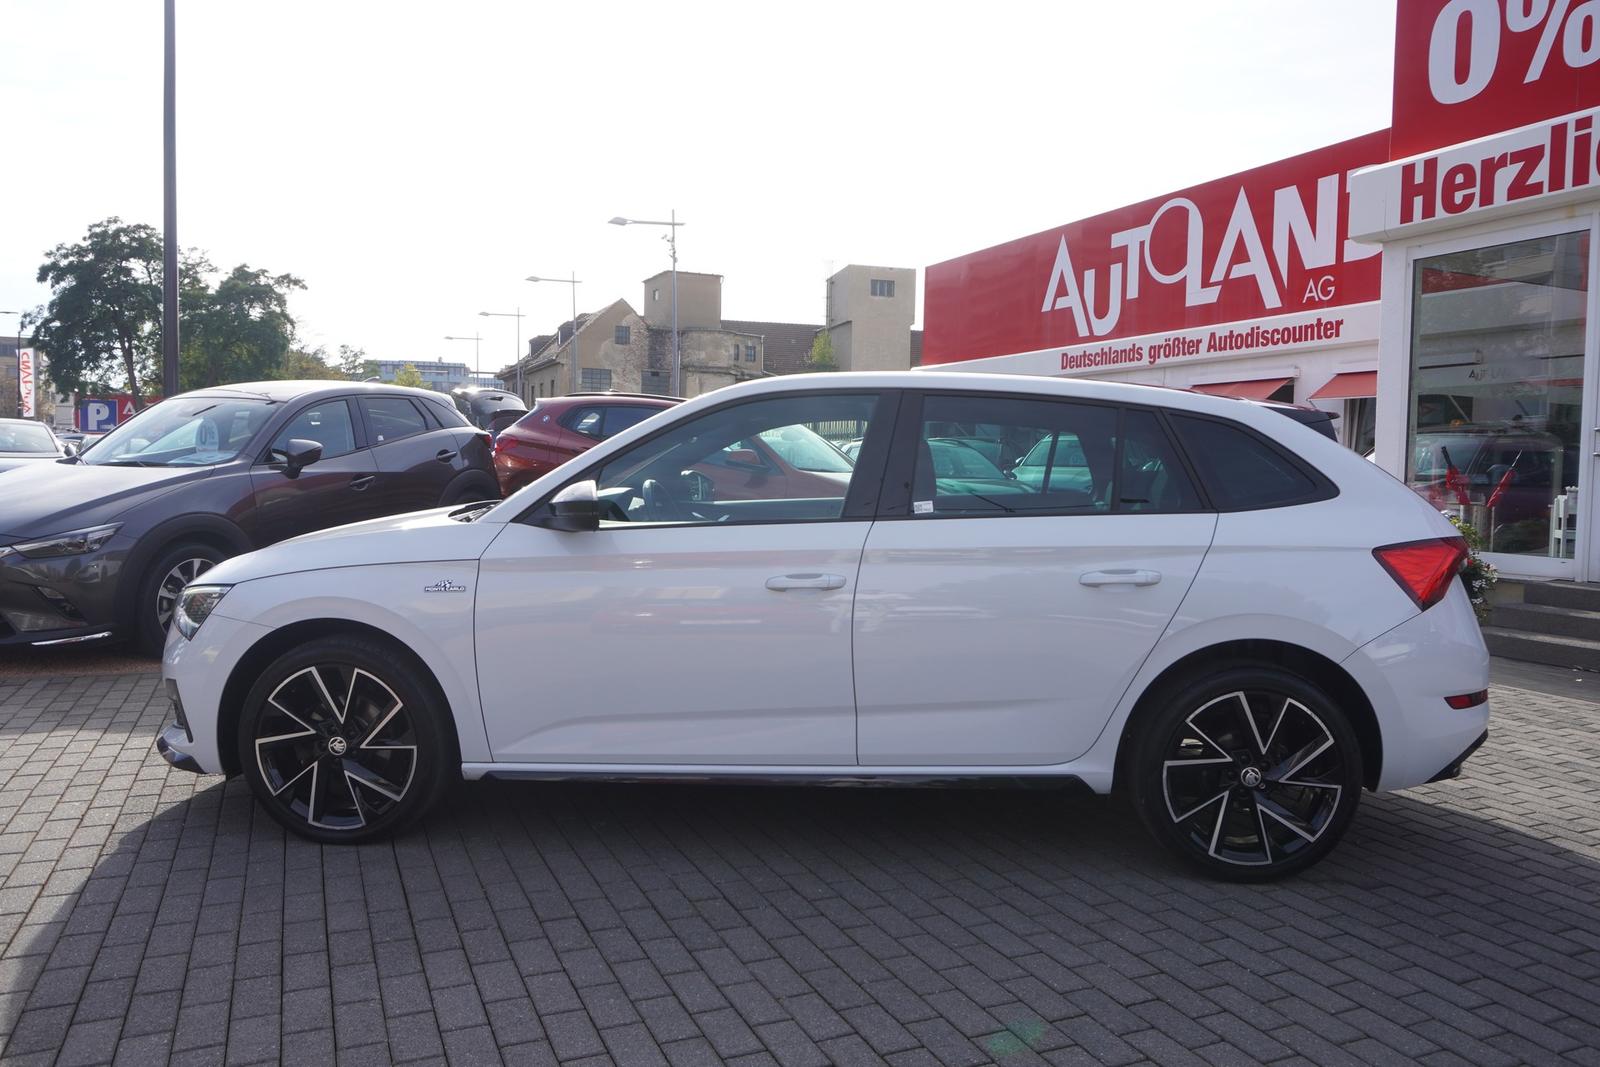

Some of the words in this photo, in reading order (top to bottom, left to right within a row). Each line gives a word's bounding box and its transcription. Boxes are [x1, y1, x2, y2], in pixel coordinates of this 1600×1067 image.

[1428, 0, 1600, 104] 0%
[1400, 115, 1600, 225] Herzli
[1302, 275, 1336, 304] AG
[1061, 343, 1143, 370] Deutschlands
[1148, 337, 1203, 365] größter
[1207, 317, 1344, 353] Autodiscounter
[88, 403, 110, 431] P
